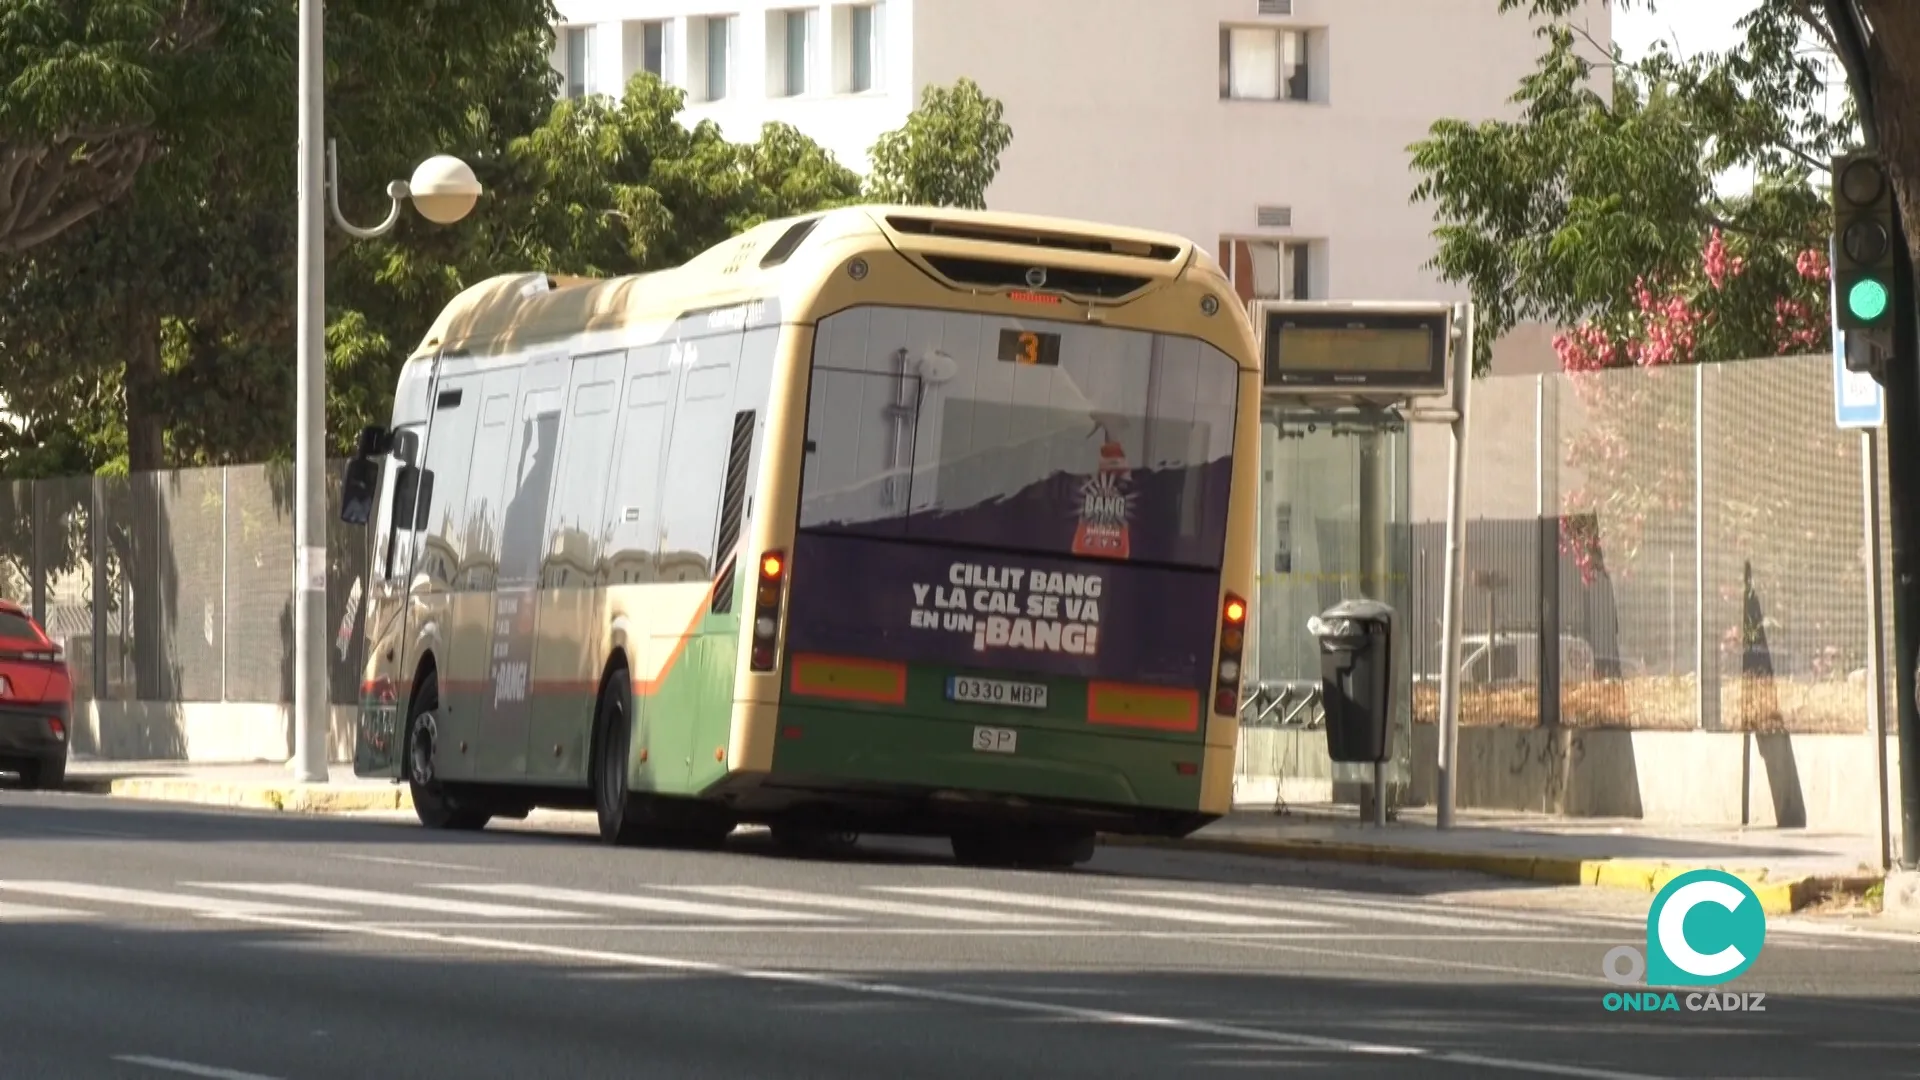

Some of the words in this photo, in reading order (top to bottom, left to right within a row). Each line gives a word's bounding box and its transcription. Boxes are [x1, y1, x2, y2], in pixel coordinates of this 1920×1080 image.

[1016, 331, 1038, 365] 3
[949, 563, 1024, 591] CILLIT
[1029, 569, 1102, 598] BANG
[912, 583, 930, 606] Y
[935, 586, 967, 610] LA
[973, 591, 1020, 615] CAL
[1026, 595, 1060, 618] SE
[1065, 599, 1100, 623] VA
[910, 609, 939, 629] EN
[943, 614, 974, 632] UN
[973, 615, 1098, 655] ¡BANG!
[958, 680, 1003, 700] 0330
[1010, 685, 1044, 704] MBP
[978, 730, 1011, 750] SP
